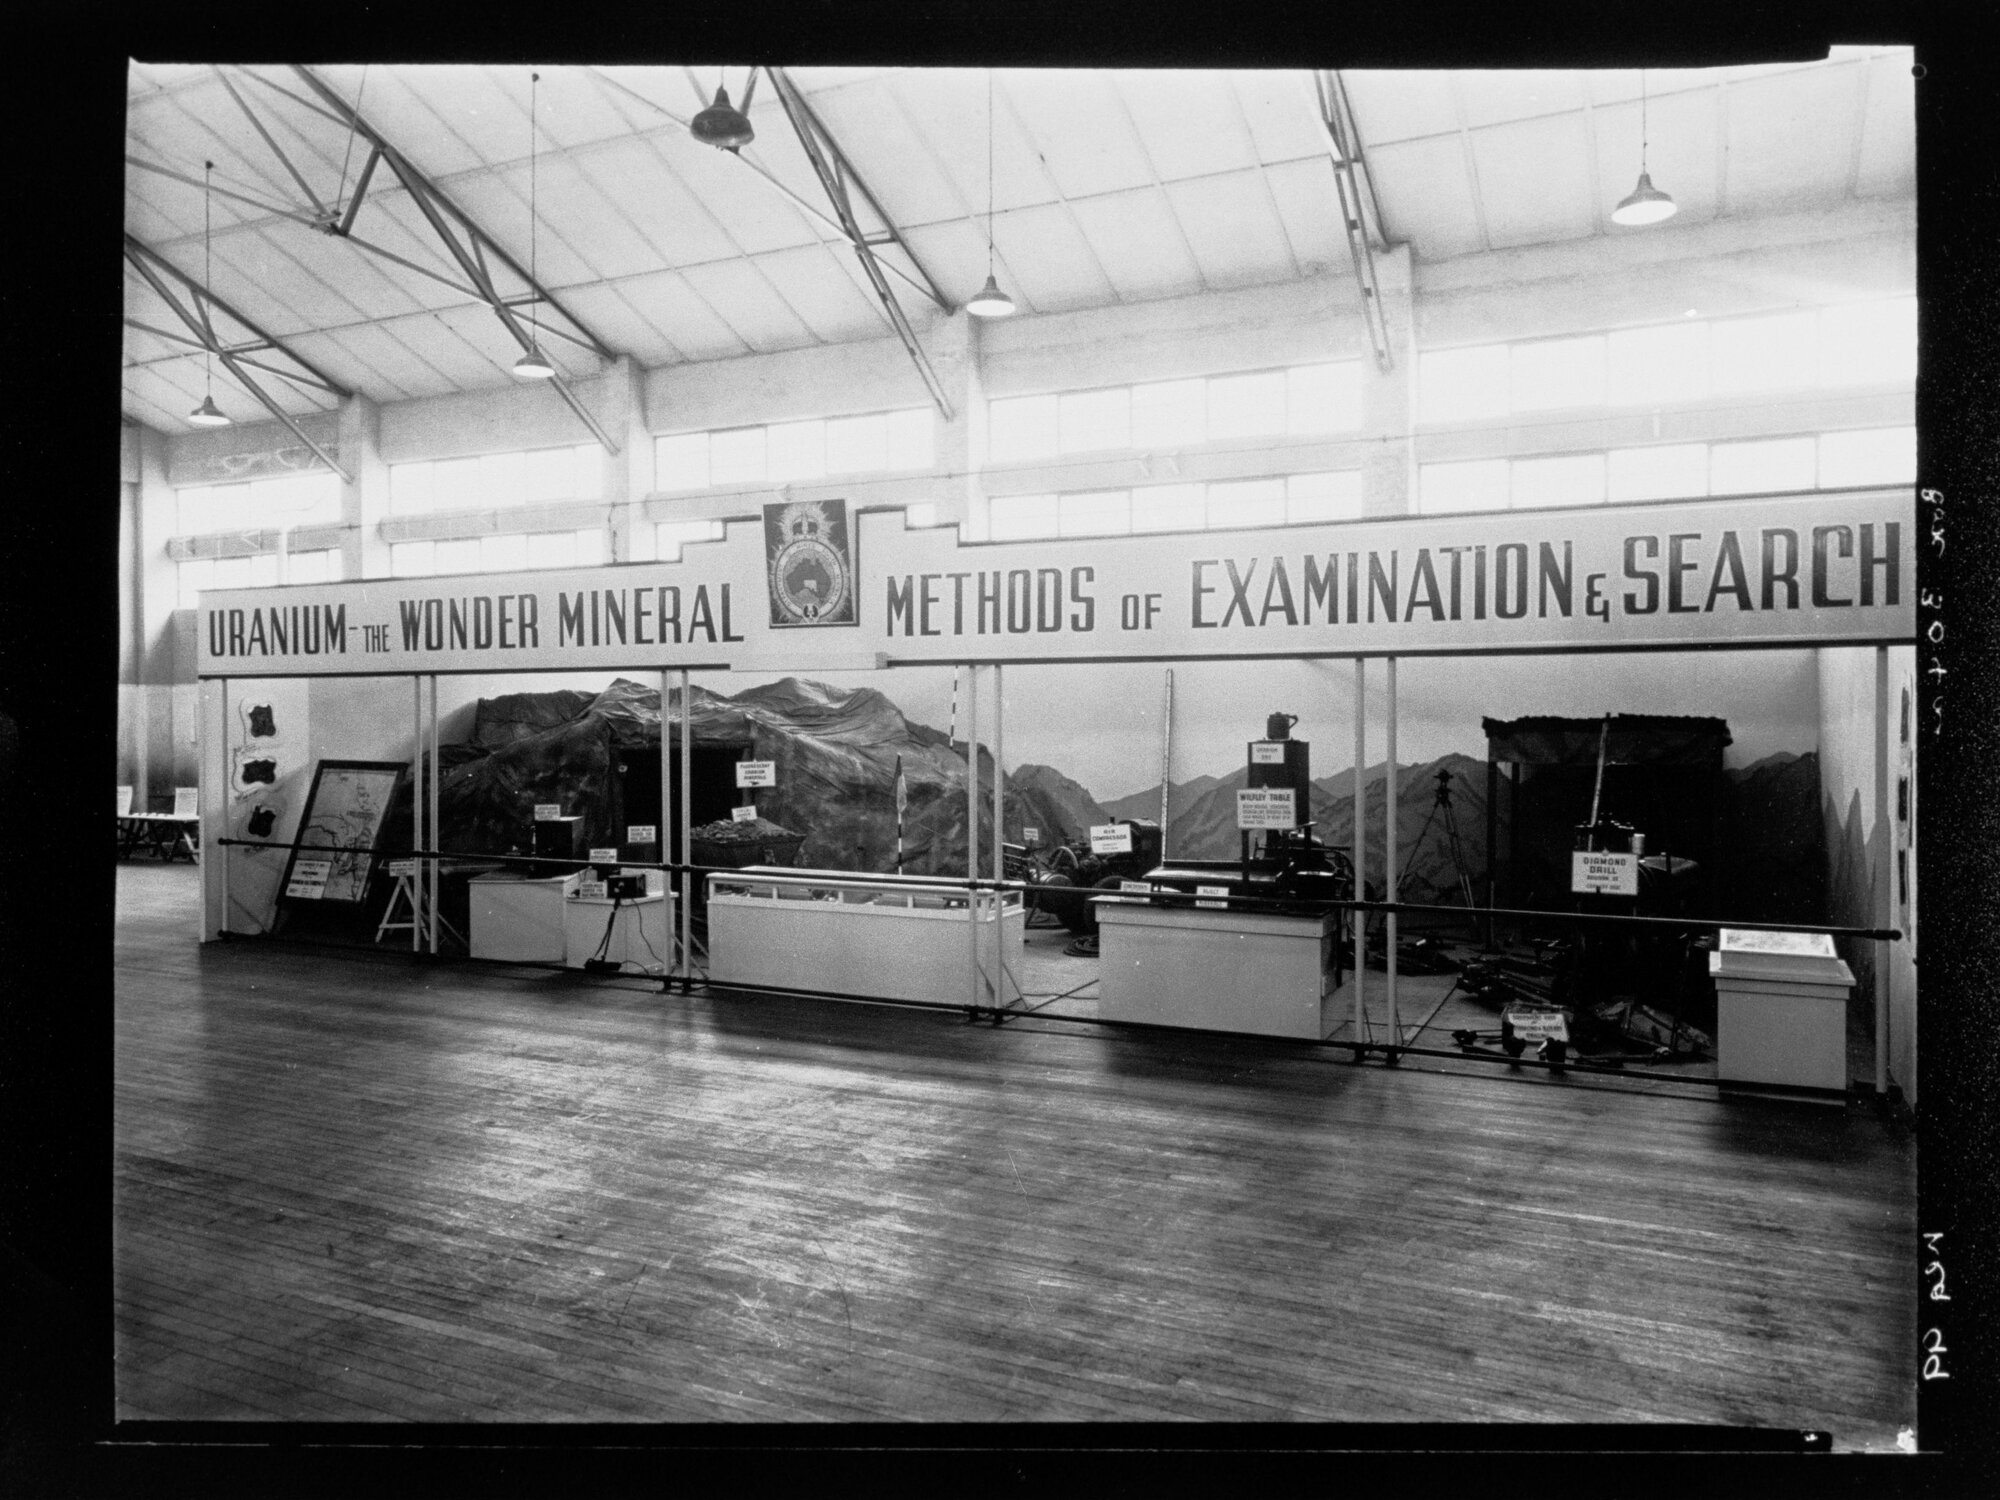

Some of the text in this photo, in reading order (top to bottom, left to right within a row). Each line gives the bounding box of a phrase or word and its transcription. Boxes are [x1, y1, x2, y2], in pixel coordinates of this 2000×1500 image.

[886, 566, 1095, 637] METHODS
[1121, 593, 1162, 631] OF
[1191, 540, 1573, 629] EXAMINATION
[1585, 573, 1610, 624] &
[1623, 521, 1901, 616] SEARCH
[363, 623, 390, 653] THE
[400, 593, 539, 653] WONDER
[558, 583, 744, 648] MINERAL
[1270, 793, 1291, 801] TABLE
[1583, 856, 1627, 867] DIAMOND
[1589, 865, 1617, 875] DRILL
